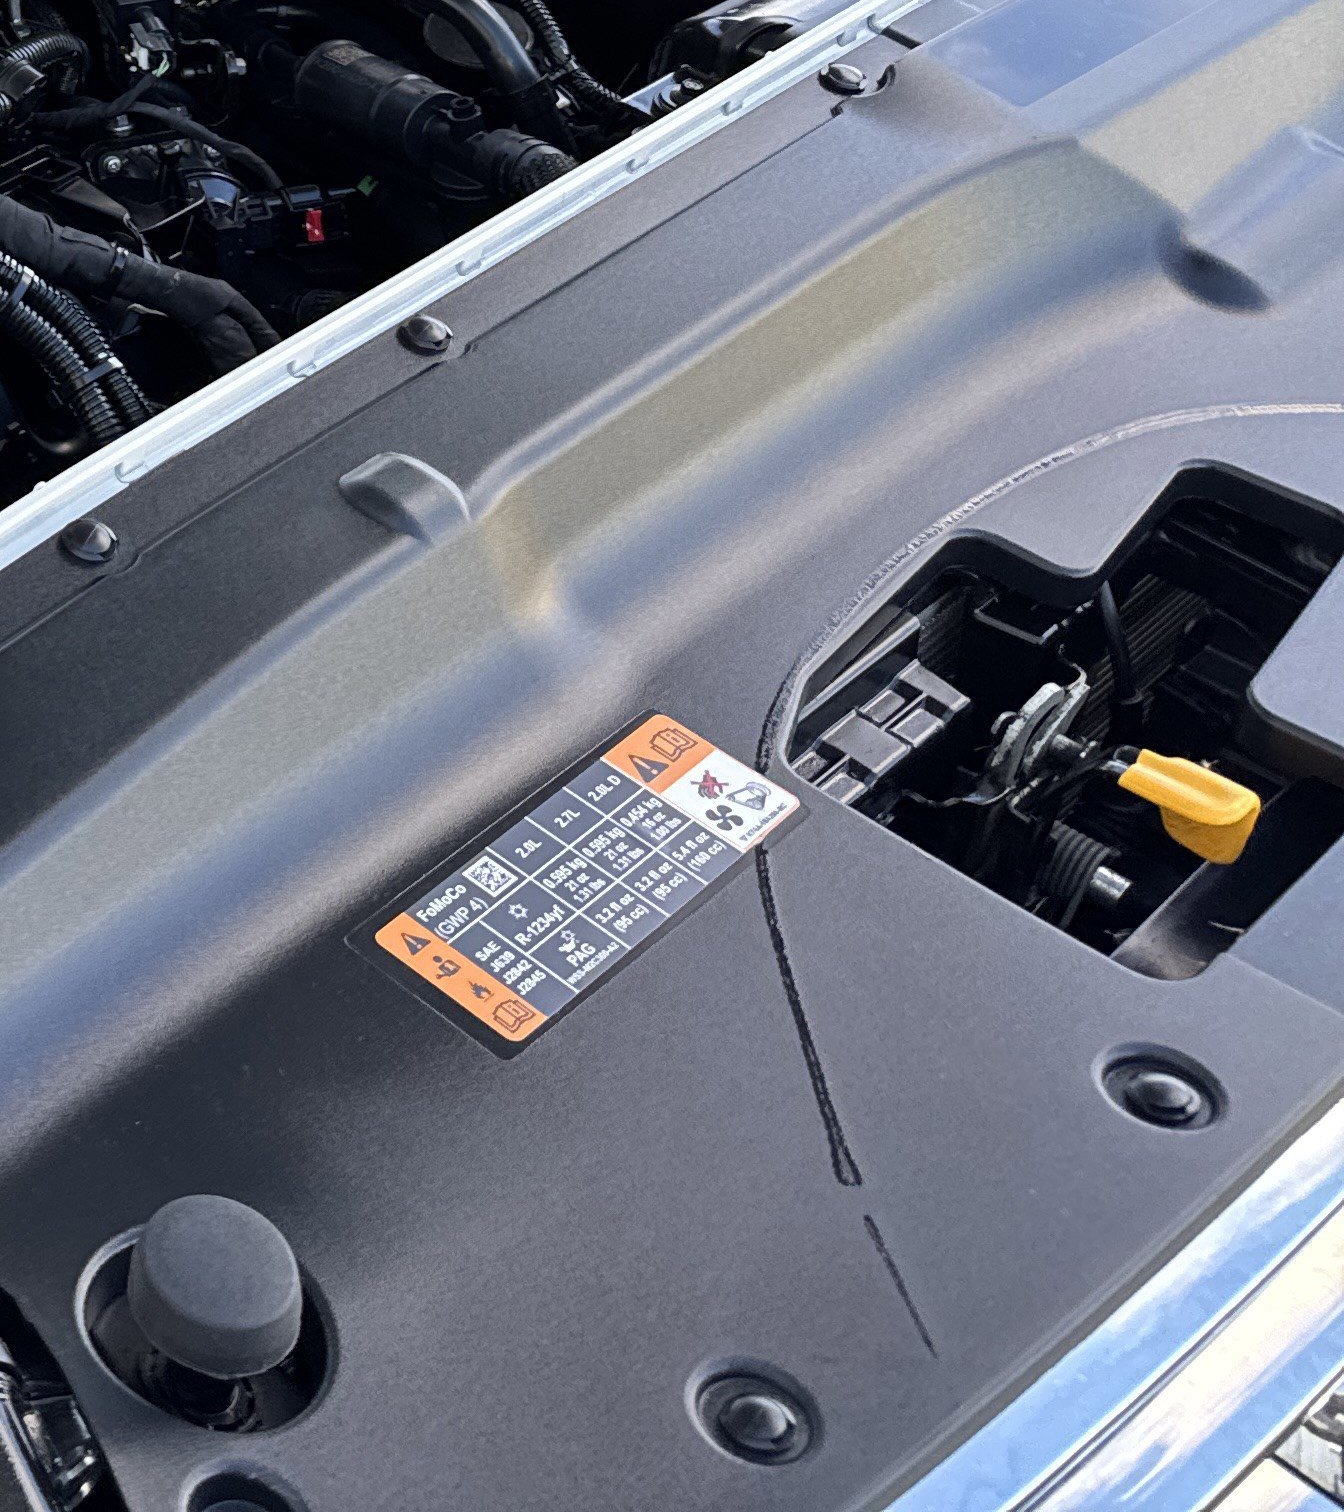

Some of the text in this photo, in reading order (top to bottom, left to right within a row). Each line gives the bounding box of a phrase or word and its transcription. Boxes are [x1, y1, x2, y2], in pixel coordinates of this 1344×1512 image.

[587, 775, 621, 802] 2.0L D
[554, 809, 580, 828] 2.7L
[620, 797, 664, 827] 0.454 kg
[642, 812, 666, 829] 16 oz
[582, 827, 626, 858] 0.595 kg
[650, 818, 682, 841] 1.00 lbs
[515, 840, 542, 858] 2.0L
[603, 841, 629, 861] 21 oz
[612, 848, 644, 871] 1.31 lbs
[672, 832, 710, 861] 5.4 fl oz
[687, 840, 727, 872] (160 cc)
[543, 858, 587, 888] 0.595 kg
[564, 873, 590, 892] 21 oz
[634, 862, 673, 892] 3.2 fl oz
[573, 878, 606, 902] 1.31 lbs
[652, 872, 688, 902] (95 cc)
[416, 884, 467, 923] FoMoCo
[595, 893, 635, 923] 3.2 fl oz
[434, 897, 489, 939] (GWP 4)
[514, 904, 565, 945] R-1234yf
[613, 902, 650, 933] (95 cc)
[475, 941, 501, 962] SAE
[490, 951, 515, 973] J639
[566, 943, 596, 967] PAG
[502, 959, 533, 984] J2842
[516, 969, 546, 996] J2845
